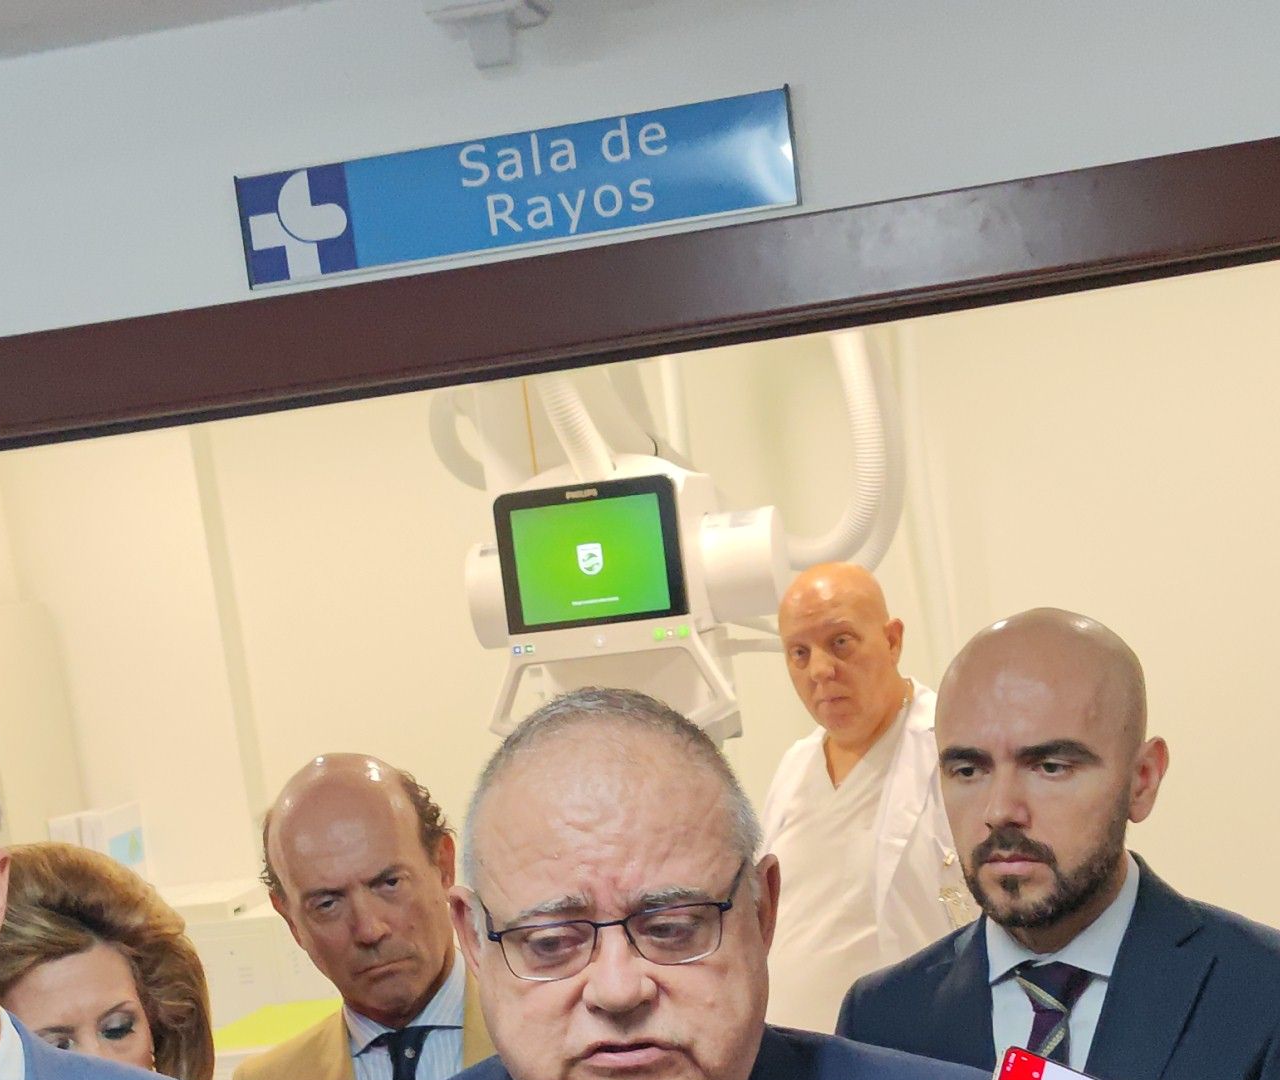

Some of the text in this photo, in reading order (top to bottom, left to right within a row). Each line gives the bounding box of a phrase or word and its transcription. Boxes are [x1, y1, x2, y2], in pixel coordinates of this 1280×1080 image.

[458, 116, 669, 189] Sala de
[485, 176, 657, 237] Rayos
